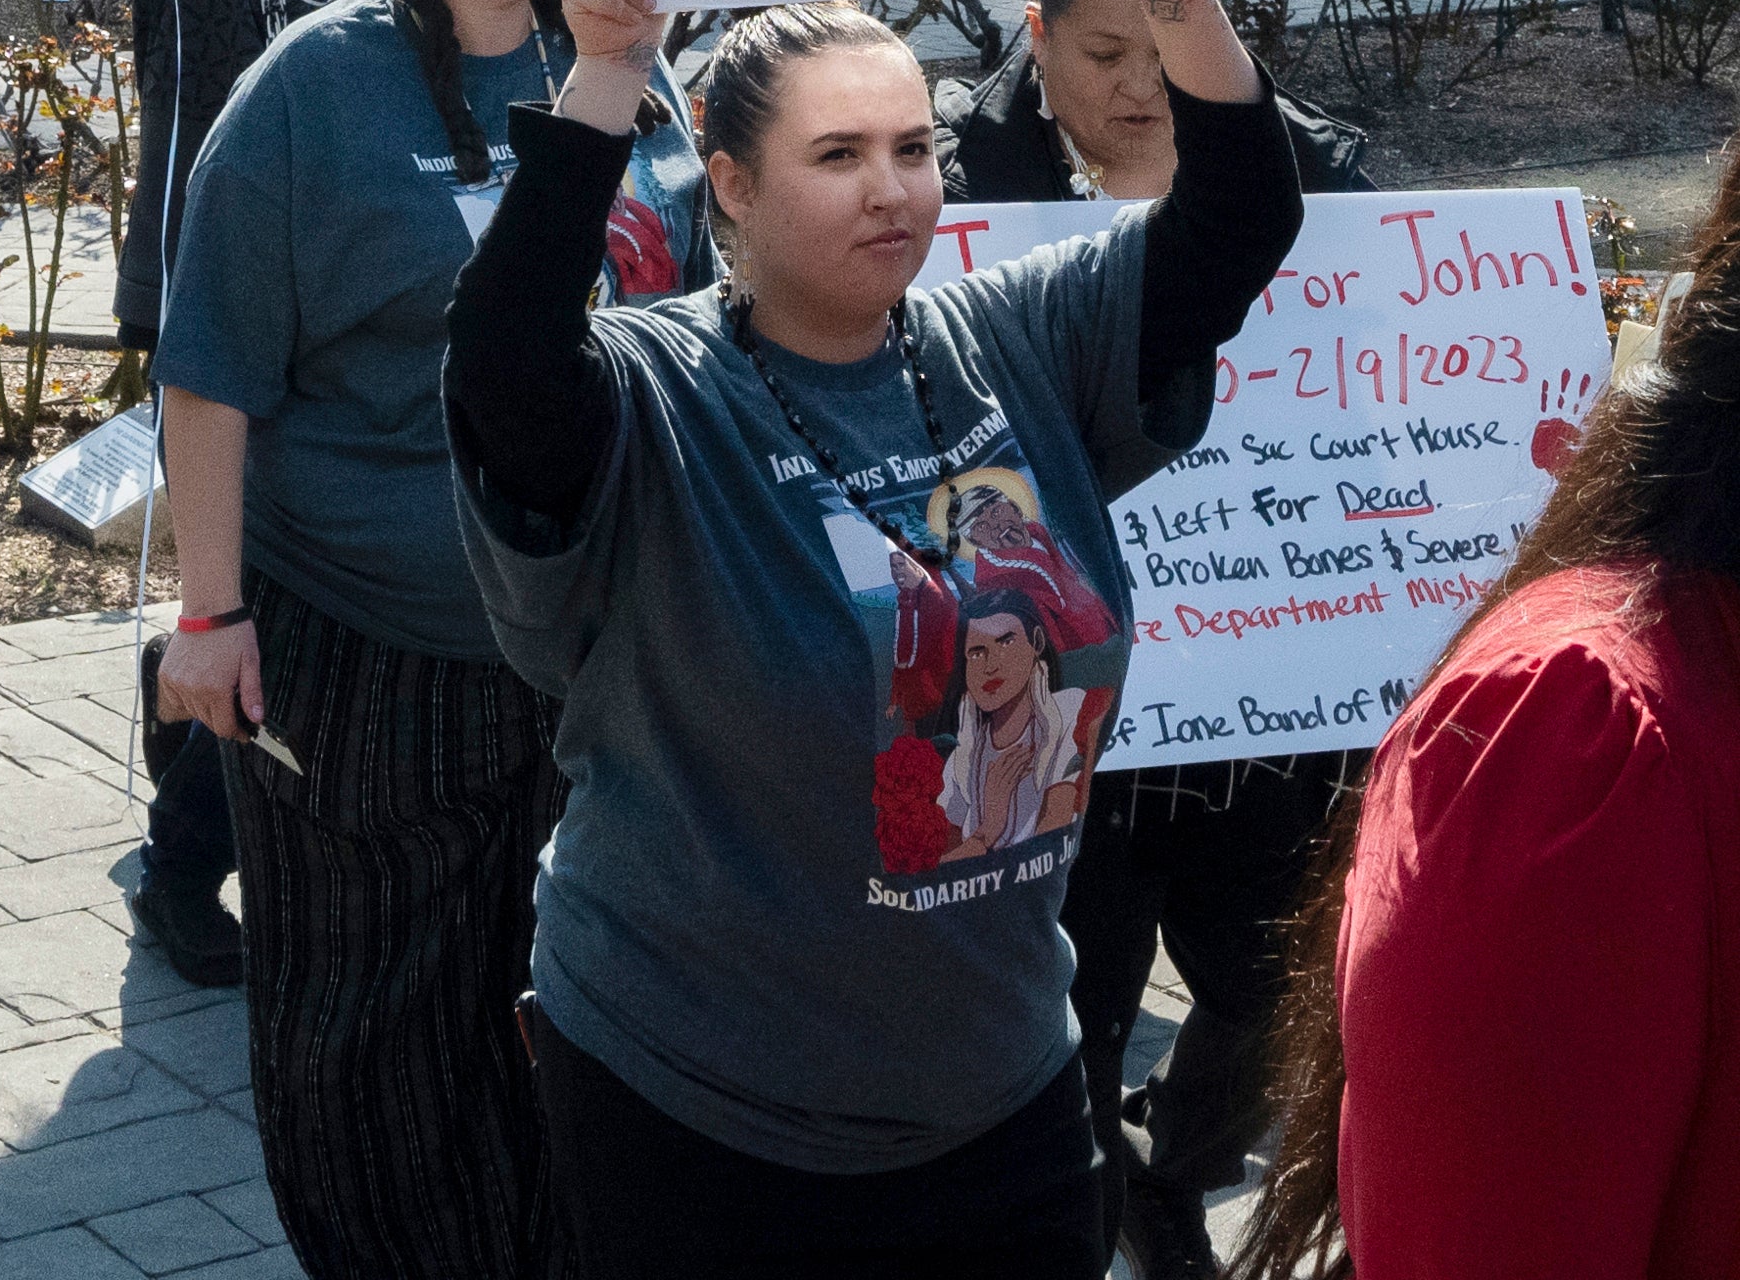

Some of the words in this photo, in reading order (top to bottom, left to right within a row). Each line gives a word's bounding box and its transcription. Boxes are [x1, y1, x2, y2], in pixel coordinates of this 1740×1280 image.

[1379, 199, 1588, 306] John!
[1241, 433, 1295, 465] Sac
[1310, 427, 1400, 461] Court
[1152, 498, 1238, 543] Left
[1251, 486, 1320, 527] For
[1146, 551, 1270, 588] Broken
[1282, 540, 1374, 578] Bones
[1406, 530, 1507, 564] Severe
[1175, 581, 1391, 641] Department
[1142, 702, 1235, 748] Ione
[1238, 693, 1327, 736] Band
[1333, 688, 1374, 725] of
[867, 877, 1005, 912] SOLIDARITY
[1014, 851, 1054, 883] AND
